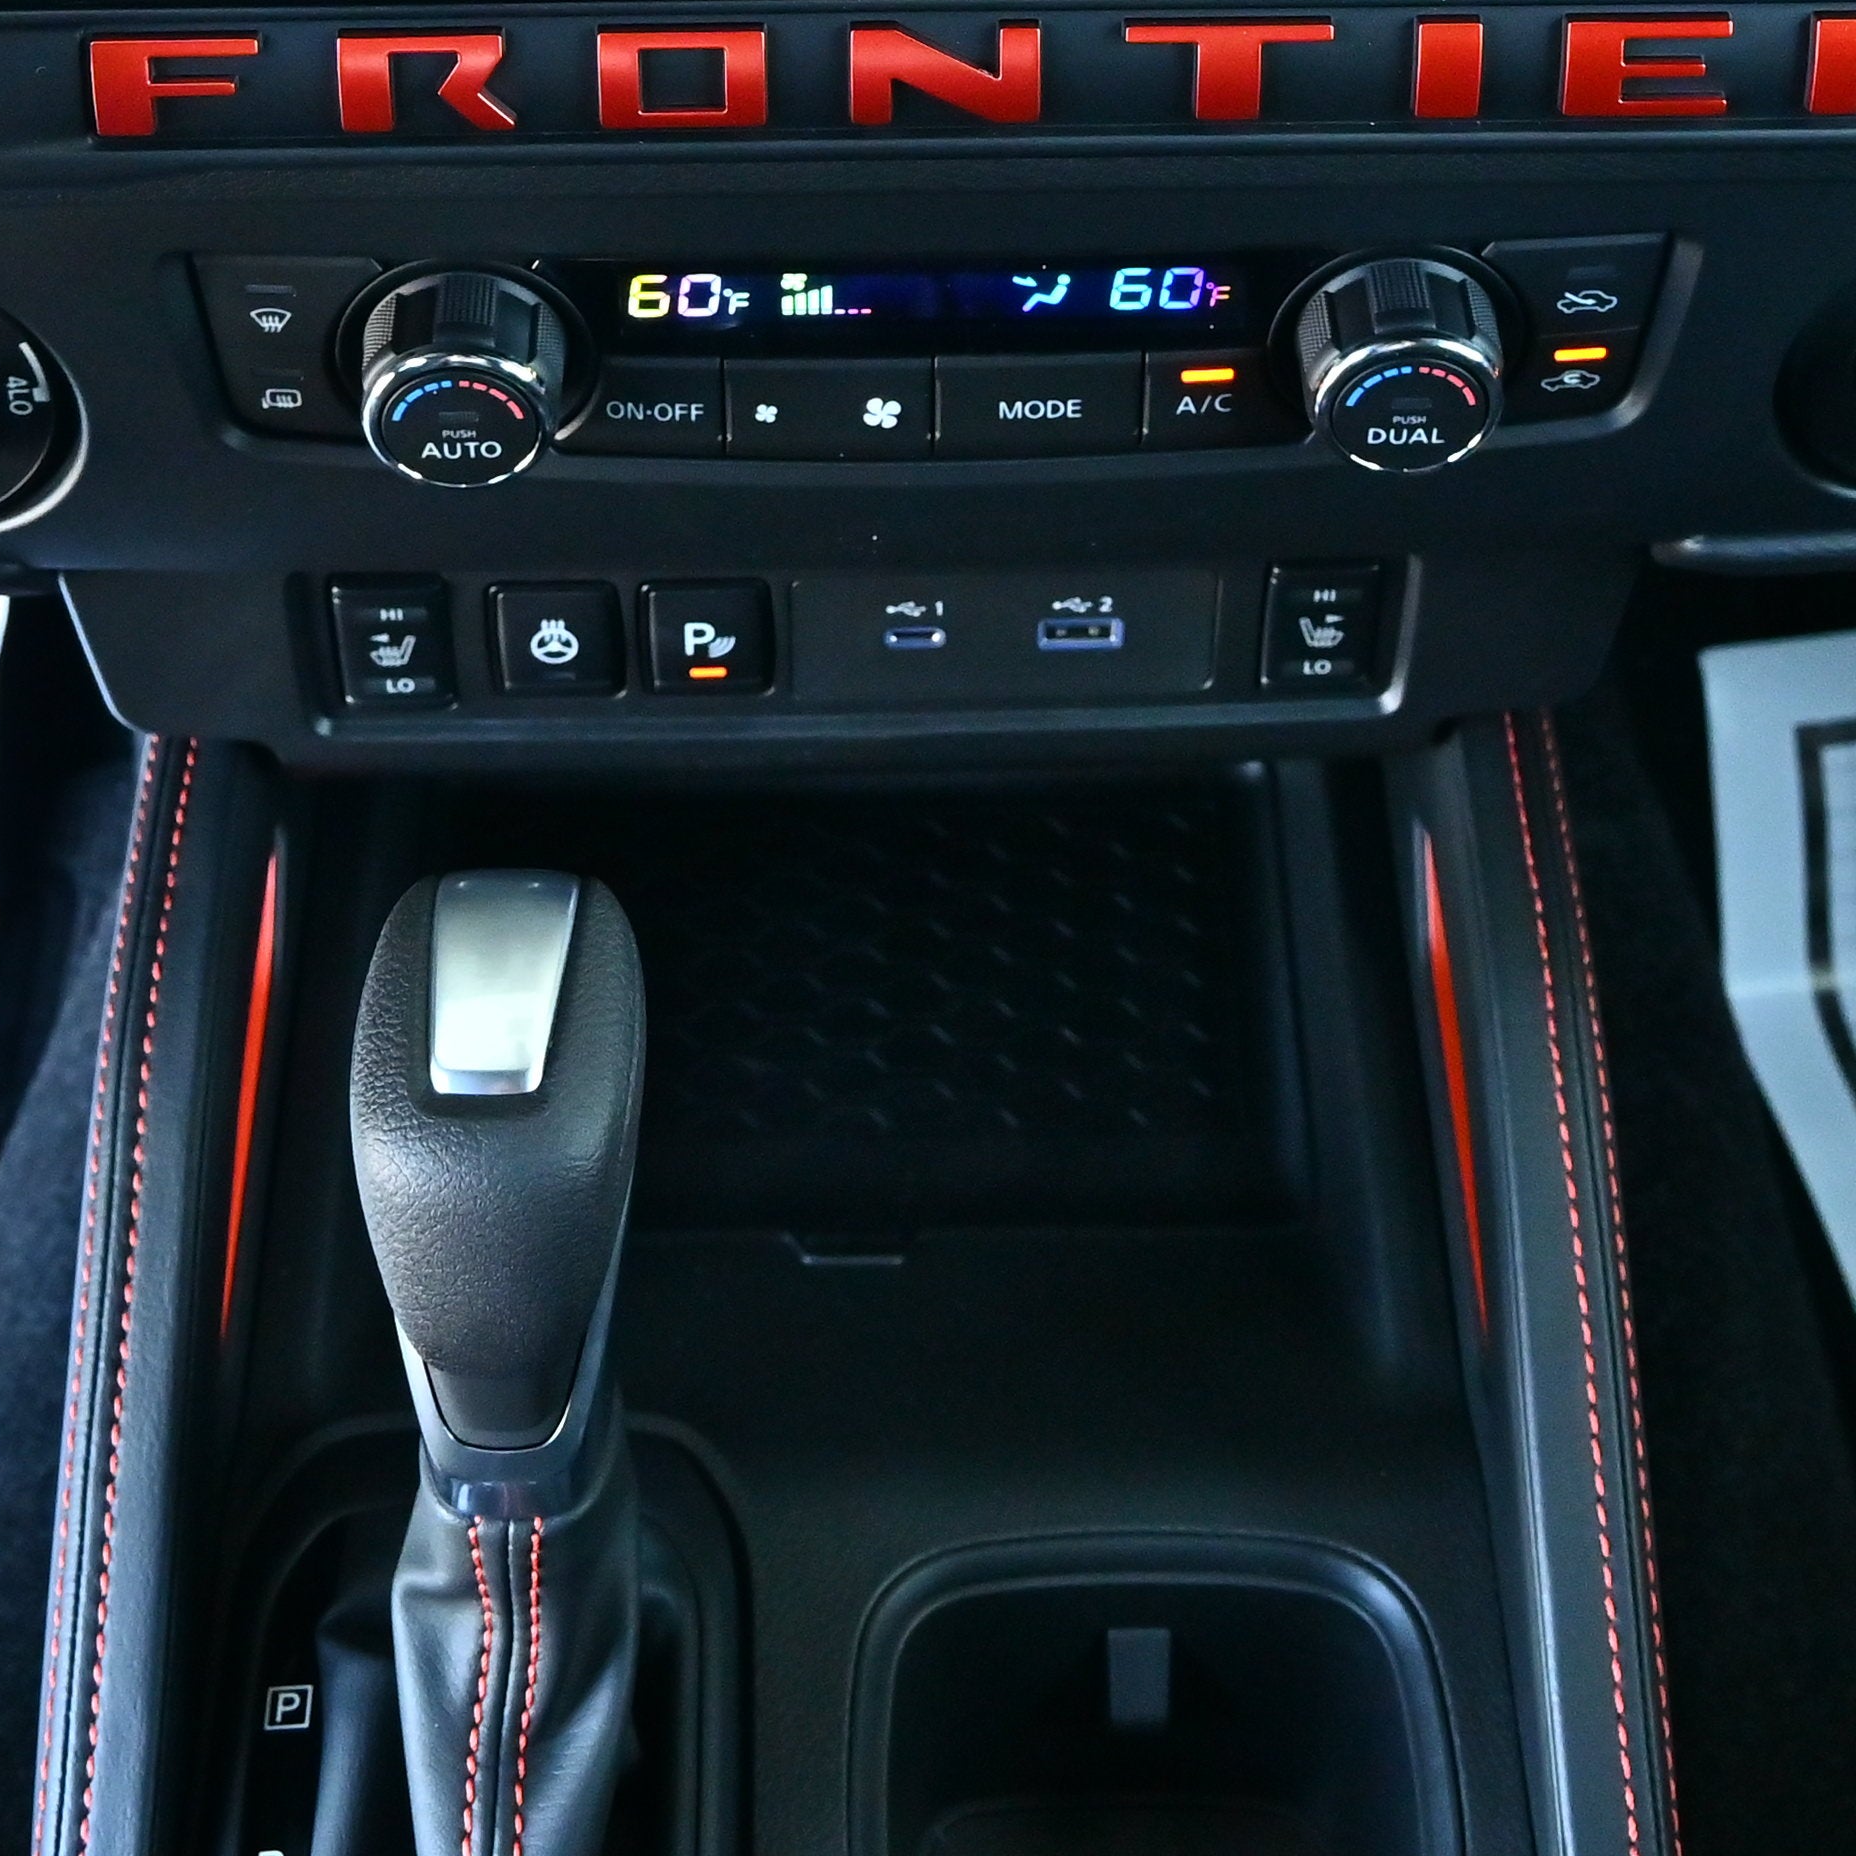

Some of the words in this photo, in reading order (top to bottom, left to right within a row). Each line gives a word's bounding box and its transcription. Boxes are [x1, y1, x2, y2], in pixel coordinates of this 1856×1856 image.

[5, 375, 34, 417] 4LO
[1175, 393, 1234, 416] A/C
[998, 399, 1083, 420] MODE
[1392, 414, 1427, 426] PUSH
[441, 428, 477, 440] PUSH
[1366, 427, 1445, 445] DUAL
[420, 440, 503, 461] AUTO
[1098, 596, 1113, 613] 2
[1312, 589, 1337, 603] HI
[379, 608, 404, 622] HI
[935, 600, 945, 617] 1
[683, 622, 717, 658] P
[1302, 660, 1333, 675] LO
[385, 678, 416, 694] LO
[275, 1692, 301, 1724] P
